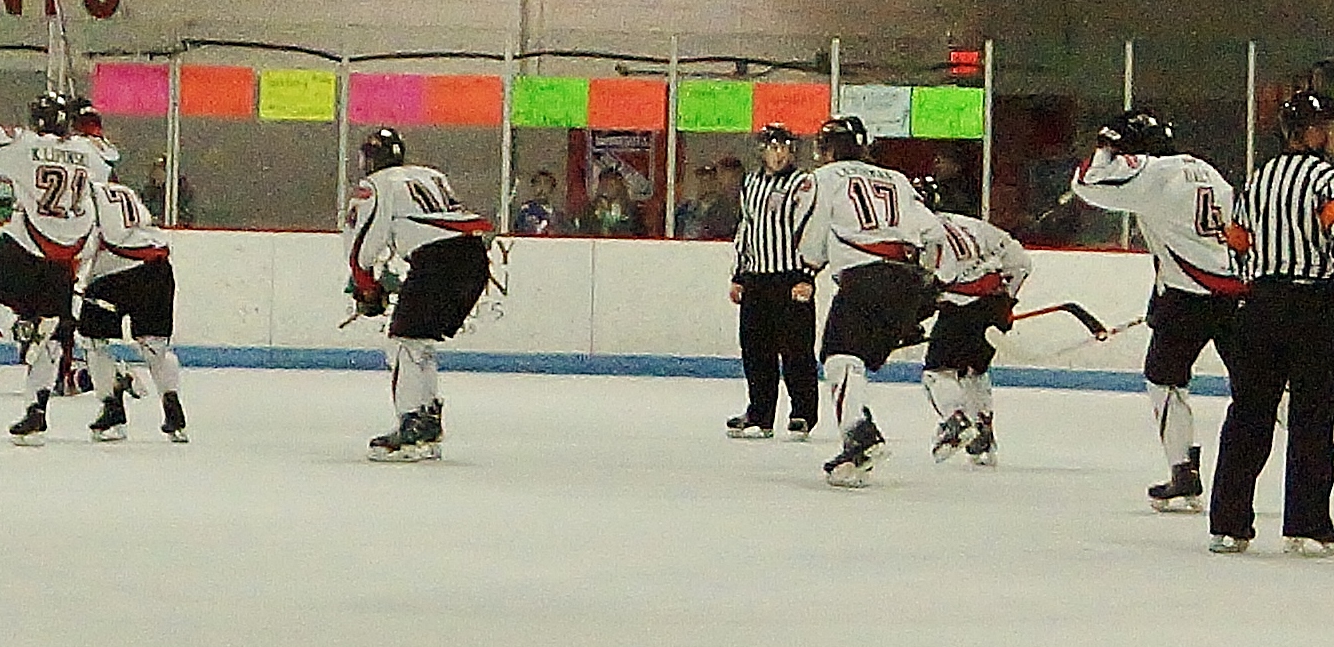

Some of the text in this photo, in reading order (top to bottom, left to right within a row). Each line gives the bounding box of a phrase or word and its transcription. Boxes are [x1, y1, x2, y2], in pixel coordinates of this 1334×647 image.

[36, 165, 89, 218] 21
[847, 176, 900, 231] 17
[1194, 186, 1228, 245] 4
